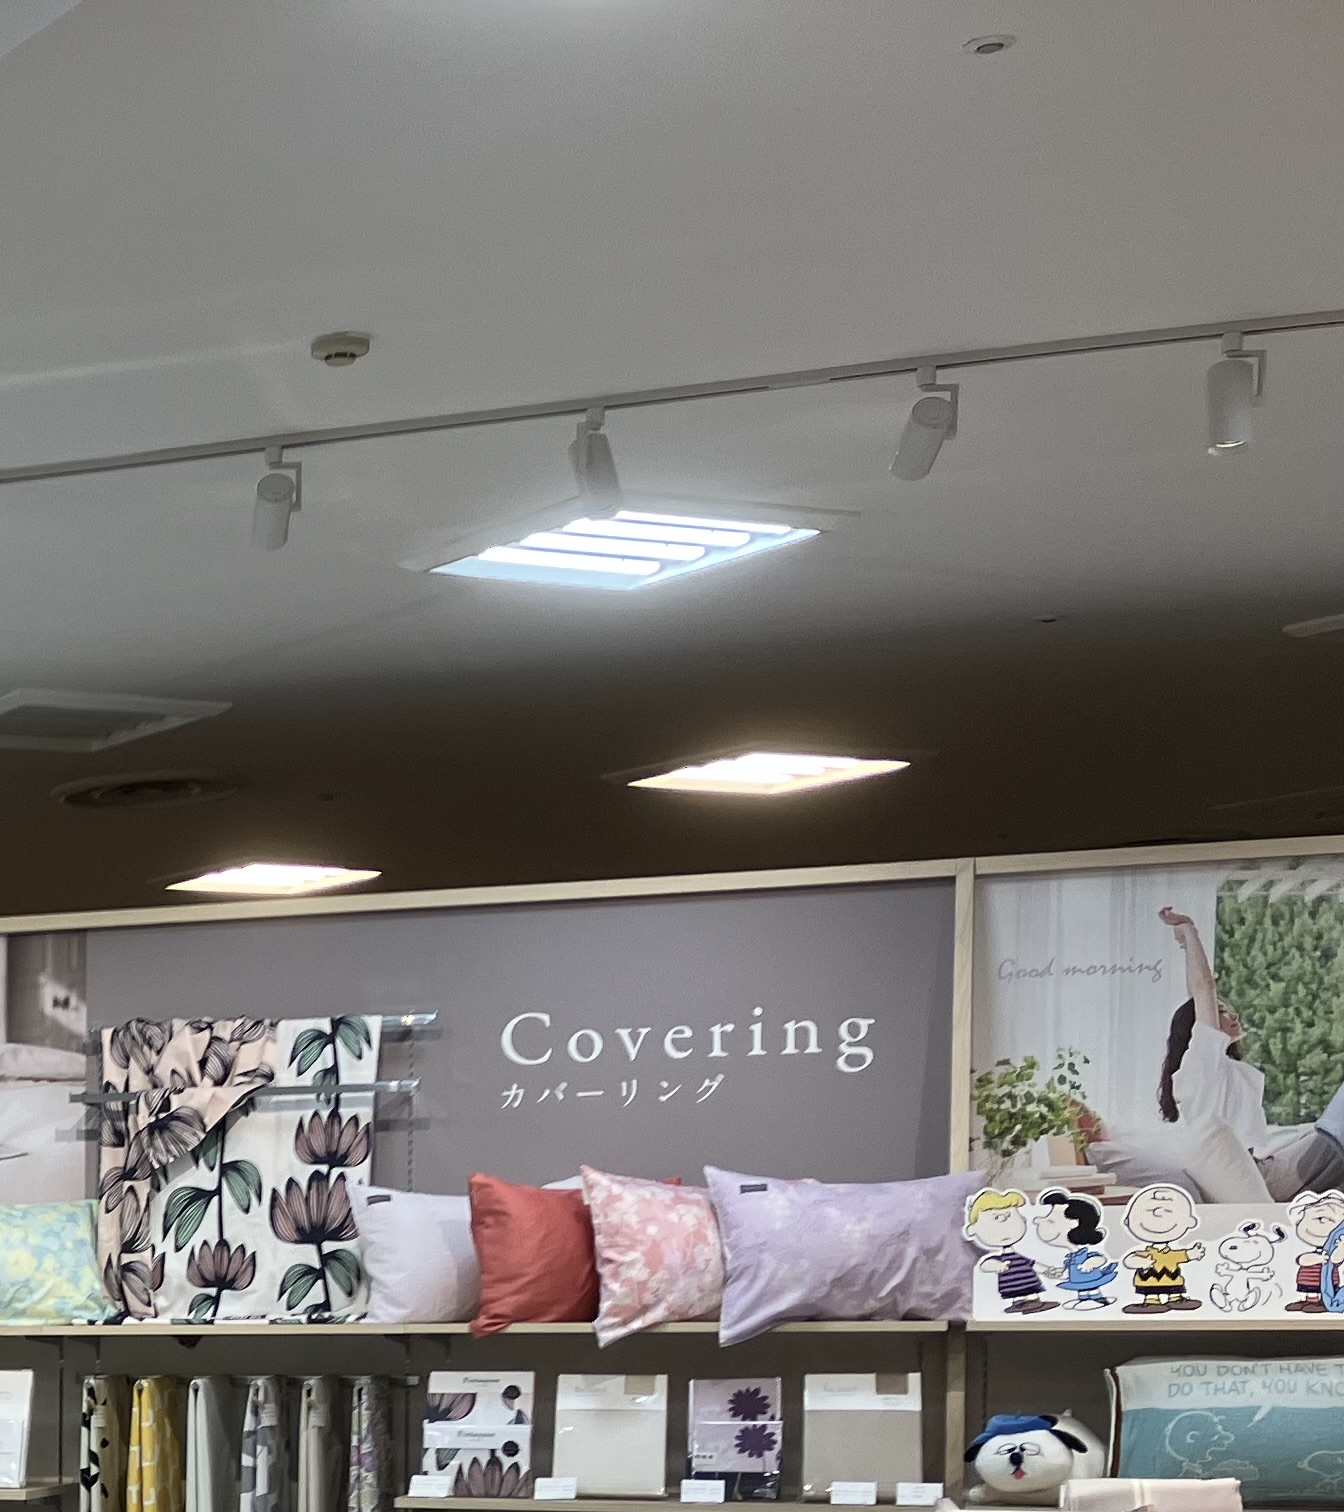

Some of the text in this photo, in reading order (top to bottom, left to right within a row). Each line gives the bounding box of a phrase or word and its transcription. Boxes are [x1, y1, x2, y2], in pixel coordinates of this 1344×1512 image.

[998, 956, 1163, 983] Good morning
[500, 1006, 876, 1074] Covering
[499, 1074, 726, 1110] カバーリング
[1171, 1364, 1207, 1377] YOU
[1217, 1363, 1272, 1376] DON'T
[1279, 1362, 1328, 1376] HAVE
[1168, 1382, 1194, 1398] DO
[1262, 1379, 1298, 1394] YOU
